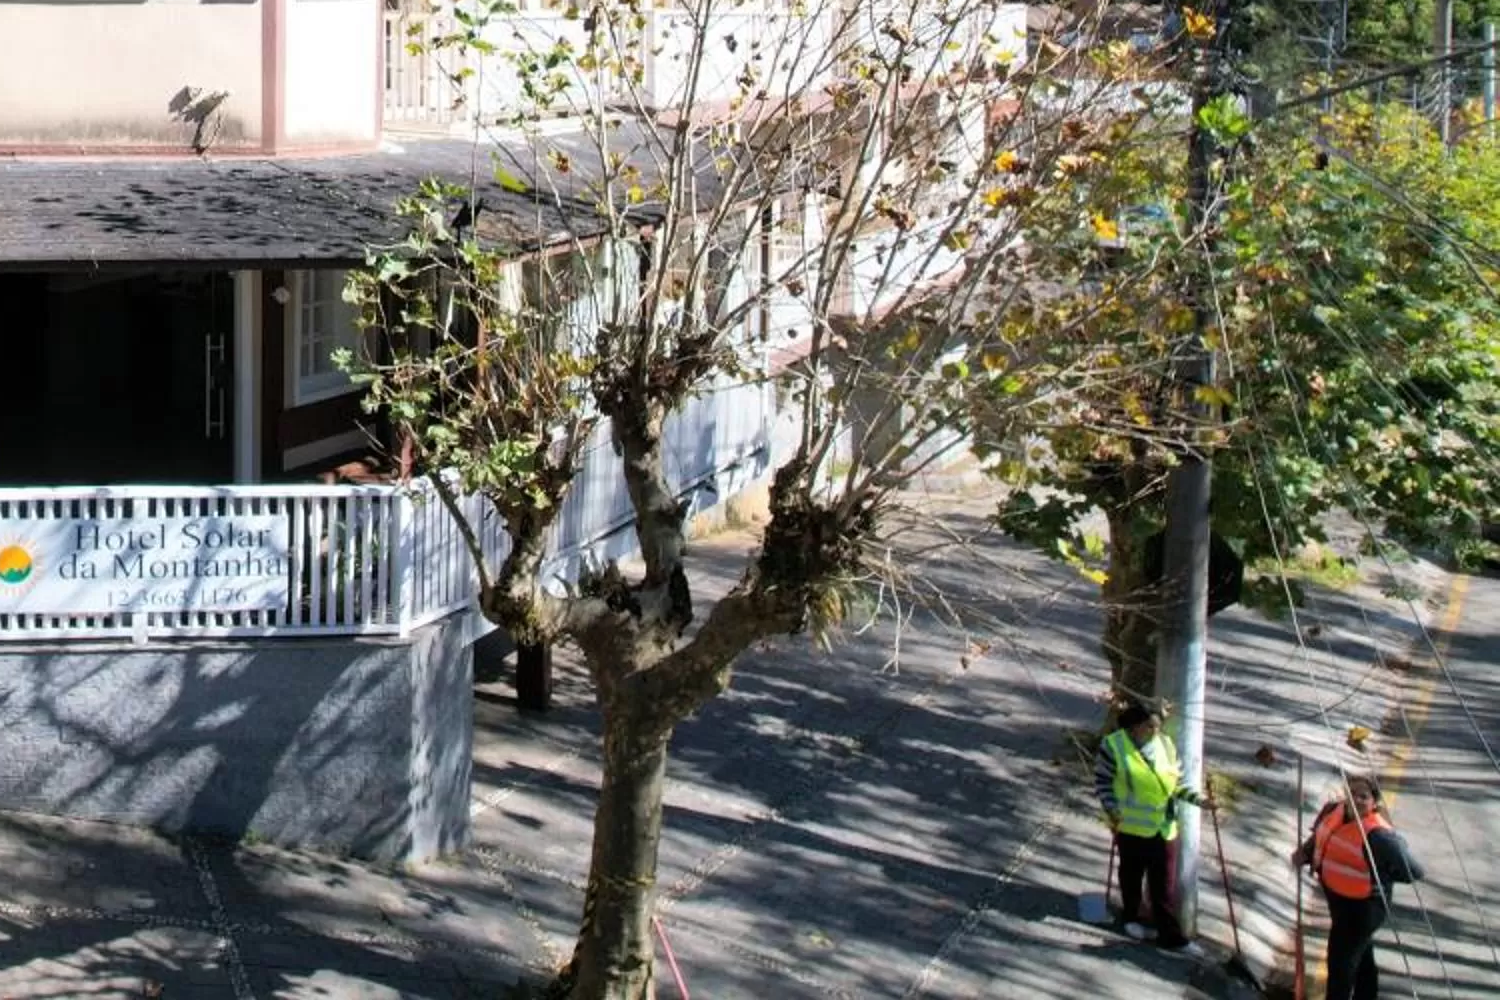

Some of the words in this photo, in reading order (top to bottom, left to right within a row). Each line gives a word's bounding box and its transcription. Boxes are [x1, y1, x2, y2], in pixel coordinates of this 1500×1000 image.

[76, 524, 166, 551] Hotel
[181, 522, 271, 549] Solar
[59, 554, 97, 580] da
[112, 551, 283, 579] Montanha
[107, 590, 130, 608] 12
